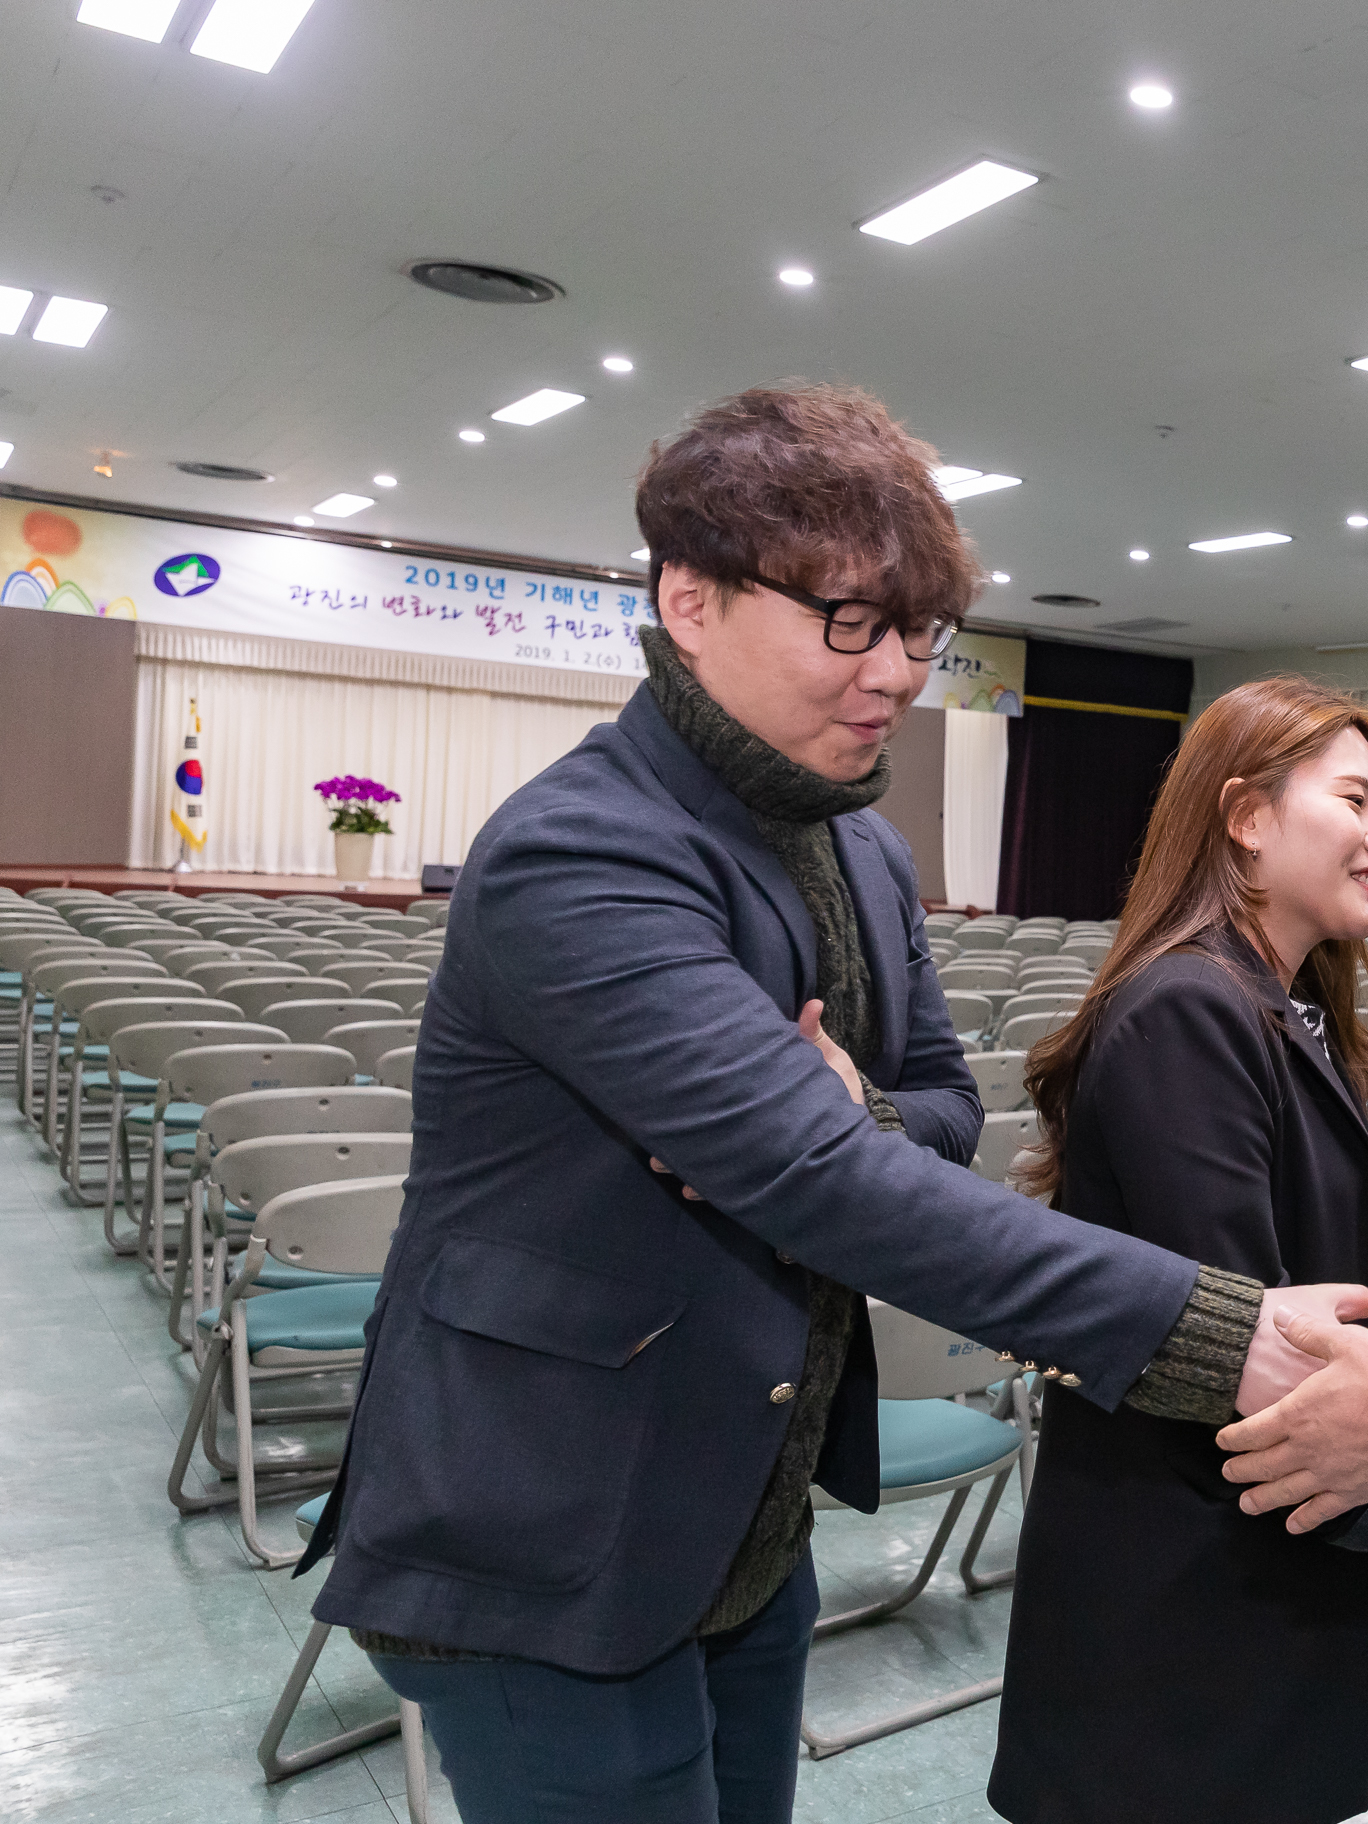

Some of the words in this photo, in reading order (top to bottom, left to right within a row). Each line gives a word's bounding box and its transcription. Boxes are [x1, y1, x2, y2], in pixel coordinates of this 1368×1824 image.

[289, 585, 368, 610] 광진의
[382, 594, 464, 621] 변화와
[475, 604, 526, 637] 발전
[545, 614, 613, 640] 구민과
[405, 564, 506, 600] 2019년
[525, 581, 599, 612] 기해년
